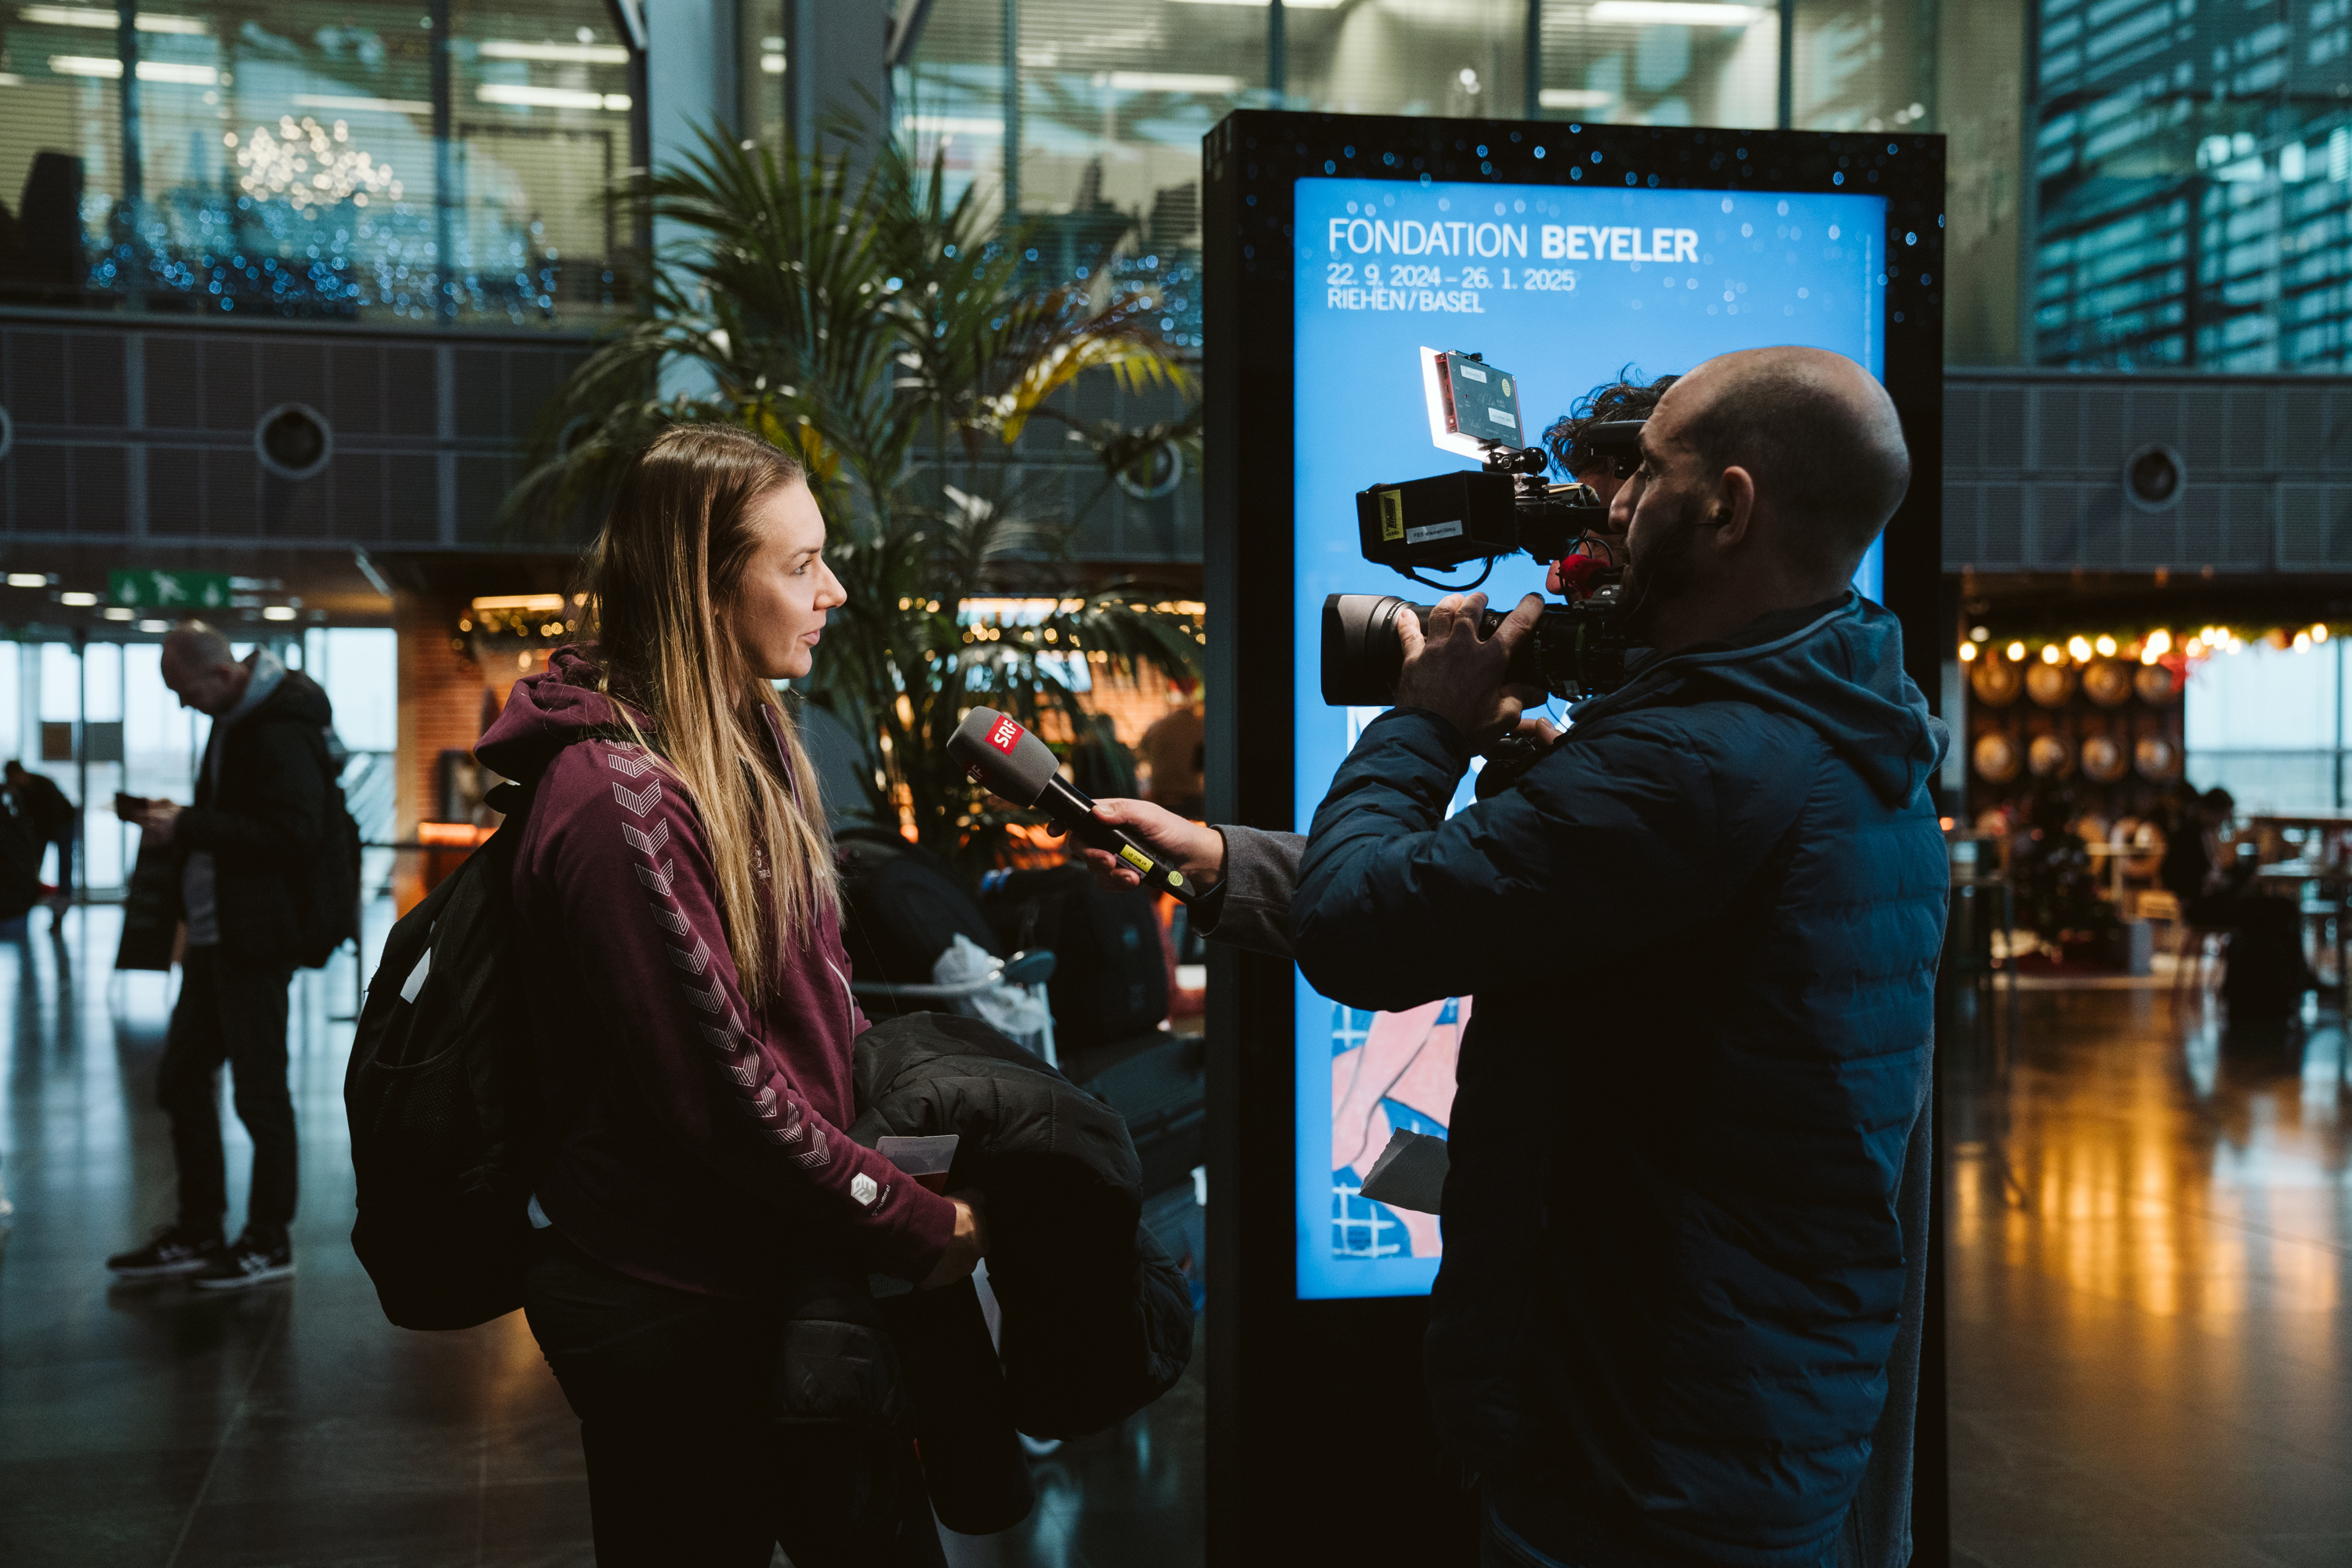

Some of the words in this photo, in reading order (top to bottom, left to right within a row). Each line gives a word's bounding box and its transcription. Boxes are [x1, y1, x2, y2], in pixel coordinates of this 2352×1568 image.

[1330, 218, 1527, 258] FONDATION
[1541, 224, 1698, 263] BEYELER
[1327, 263, 1359, 285] 22.
[1364, 263, 1384, 288] 9.
[1501, 267, 1518, 290] 1.
[1524, 267, 1576, 291] 2025
[994, 720, 1017, 748] SRF
[967, 764, 983, 782] RF
[877, 1184, 891, 1210] hummel
